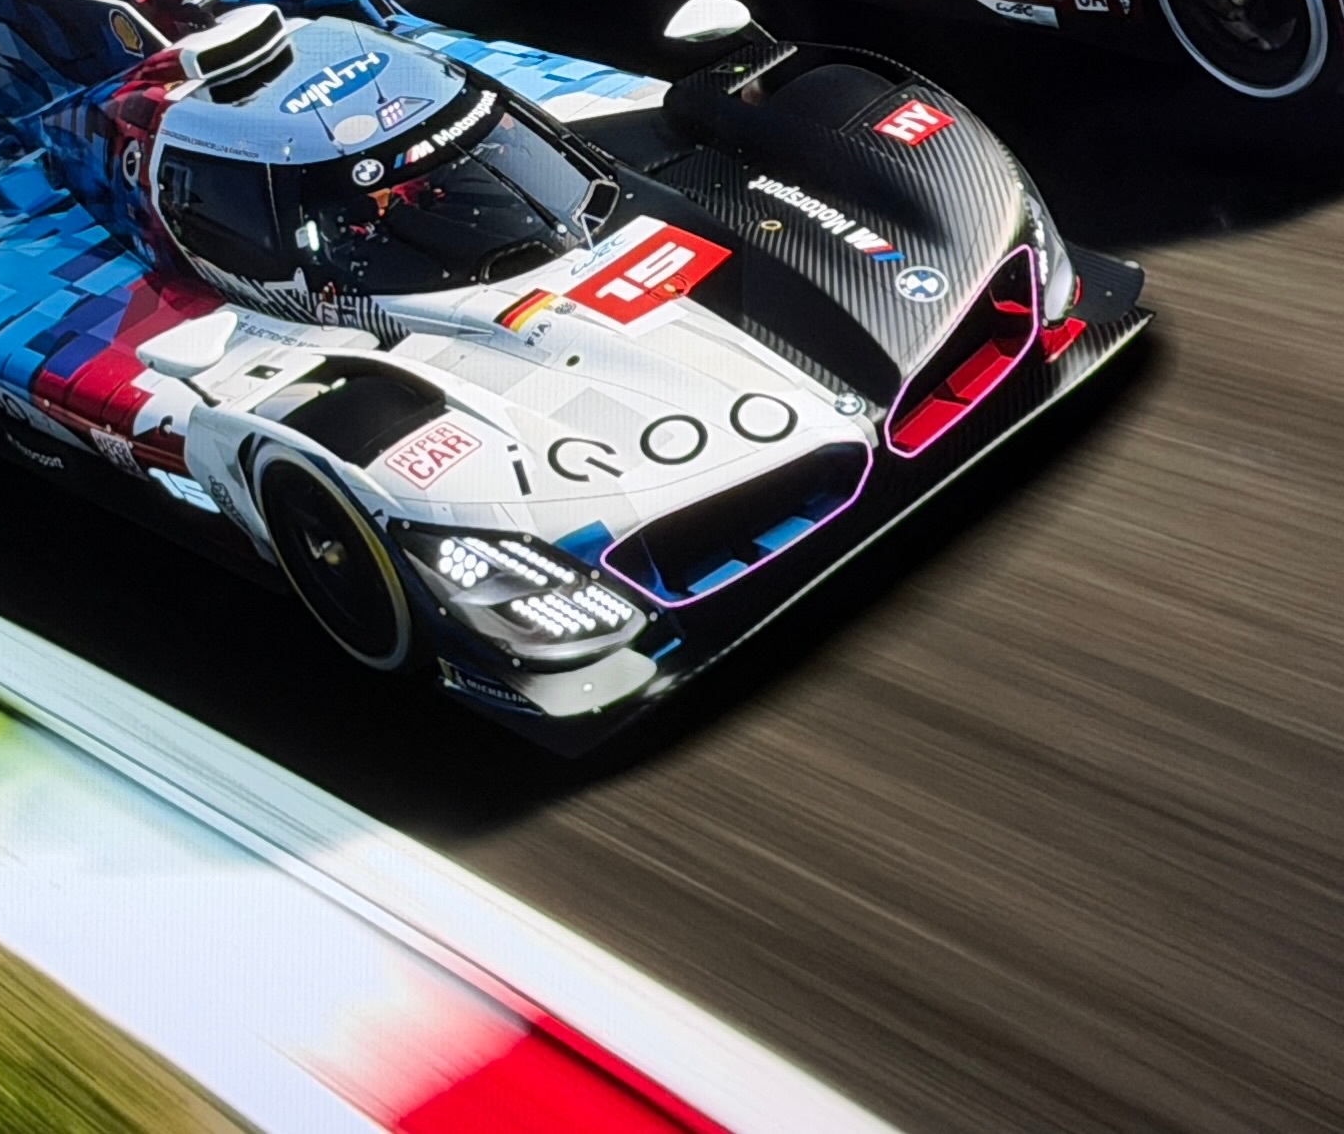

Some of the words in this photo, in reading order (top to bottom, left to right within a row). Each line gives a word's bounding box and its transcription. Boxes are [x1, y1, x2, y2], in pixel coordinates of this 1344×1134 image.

[286, 52, 381, 114] MINTH
[431, 89, 498, 147] Motorsport
[881, 102, 939, 142] HY
[748, 174, 856, 235] Motorsport
[595, 240, 697, 302] 15
[392, 426, 454, 468] HYPER
[407, 434, 473, 480] CAR
[506, 391, 798, 496] iQOO
[147, 467, 222, 514] 15
